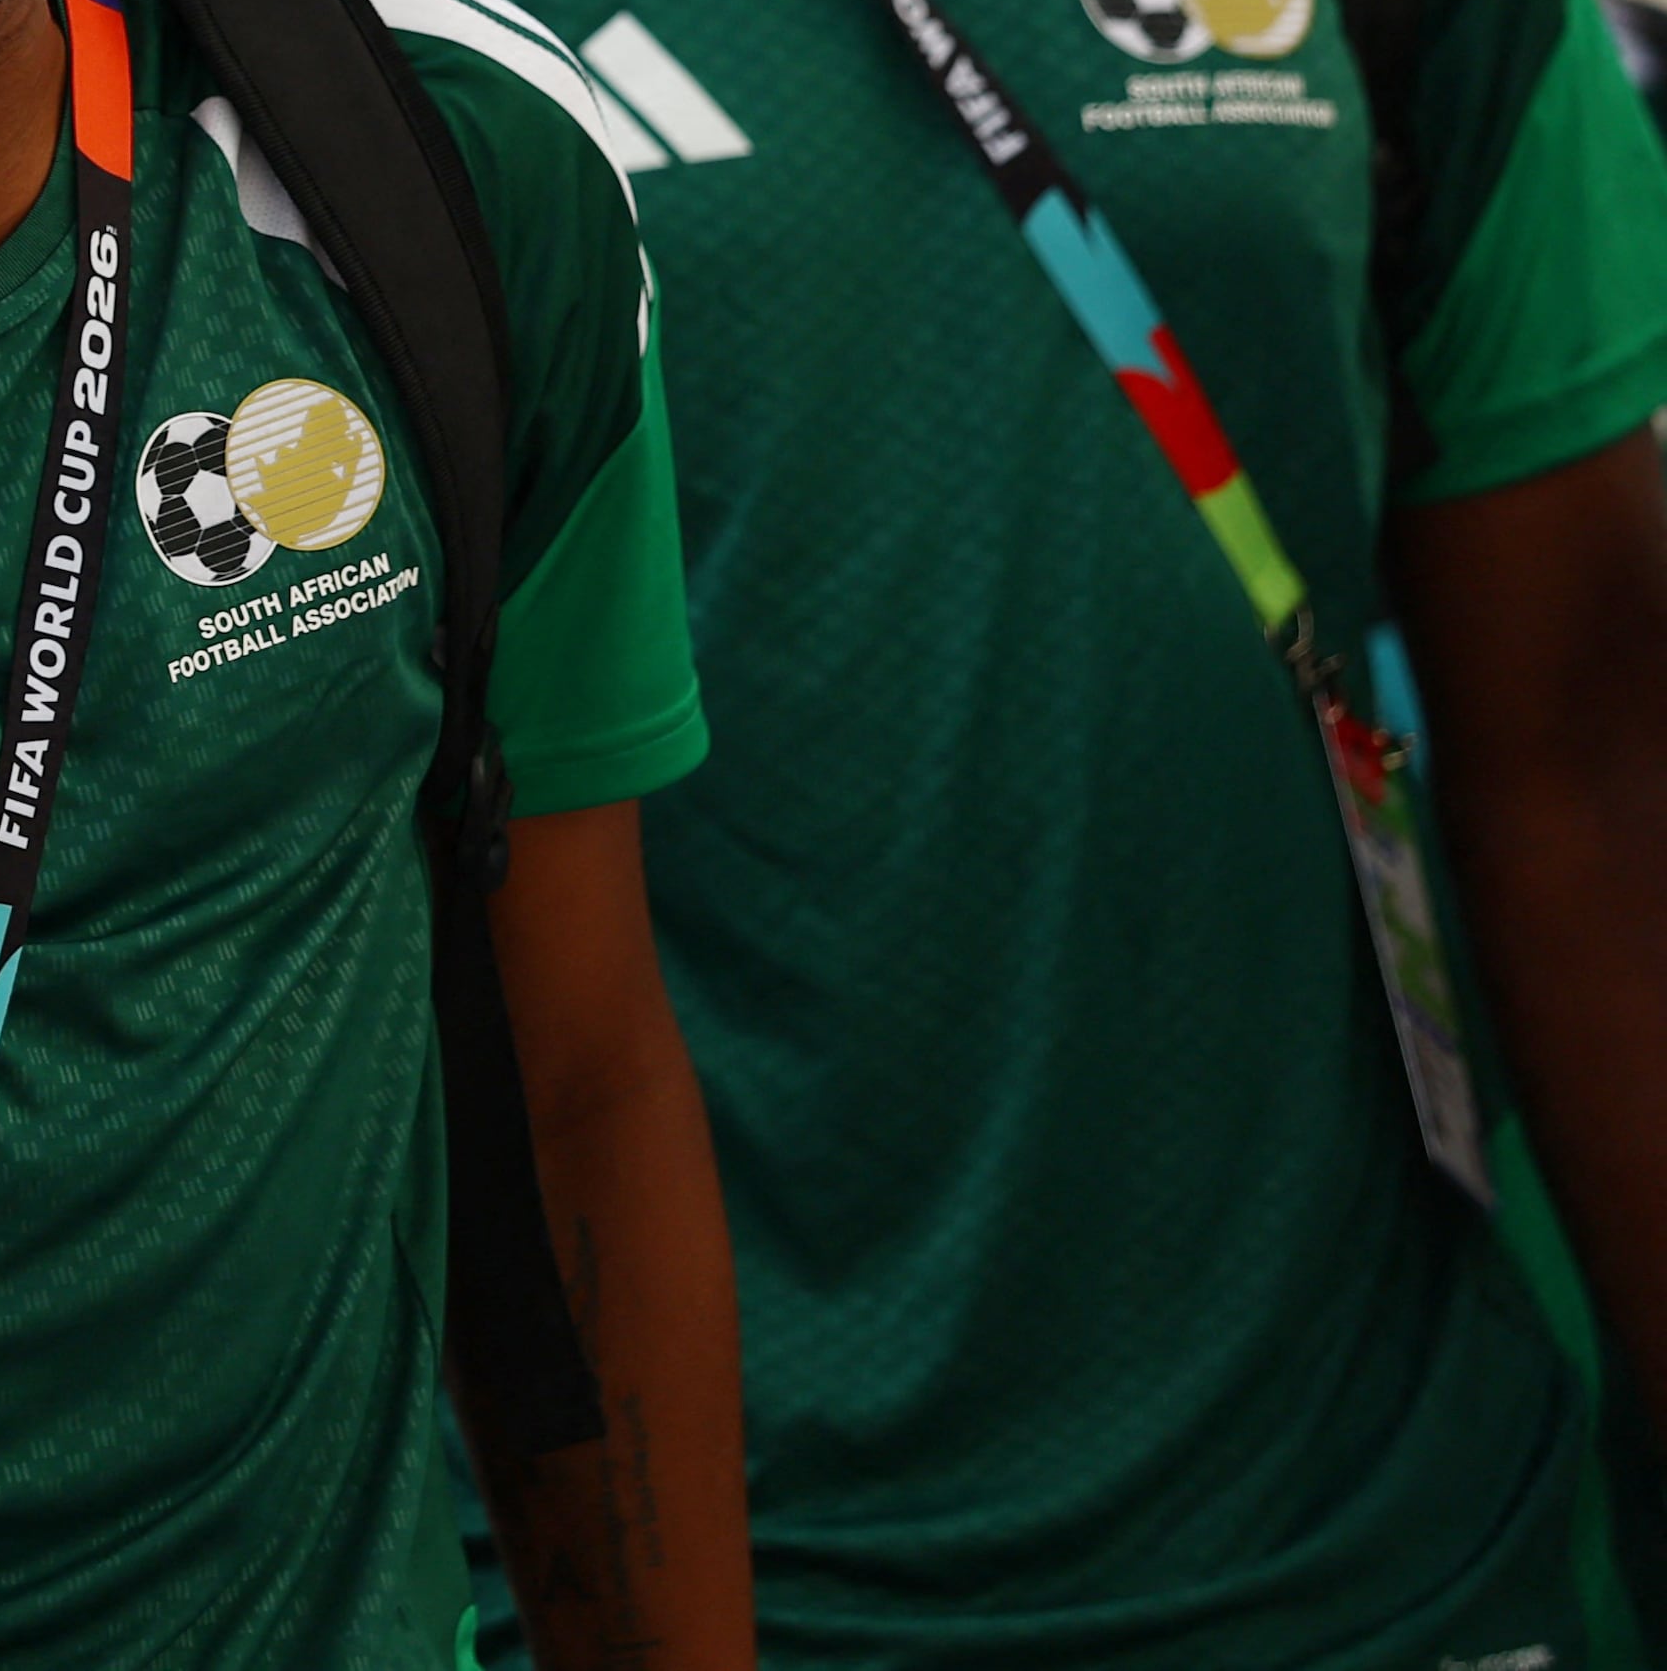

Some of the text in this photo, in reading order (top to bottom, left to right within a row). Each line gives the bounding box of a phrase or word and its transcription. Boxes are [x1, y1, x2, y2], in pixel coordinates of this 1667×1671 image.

[944, 55, 1028, 165] FIFA
[21, 535, 84, 722] WORLD
[53, 419, 101, 525] CUP
[168, 566, 419, 683] FOOTBALL ASSOCIATON
[198, 552, 391, 639] SOUTH AFRICAN
